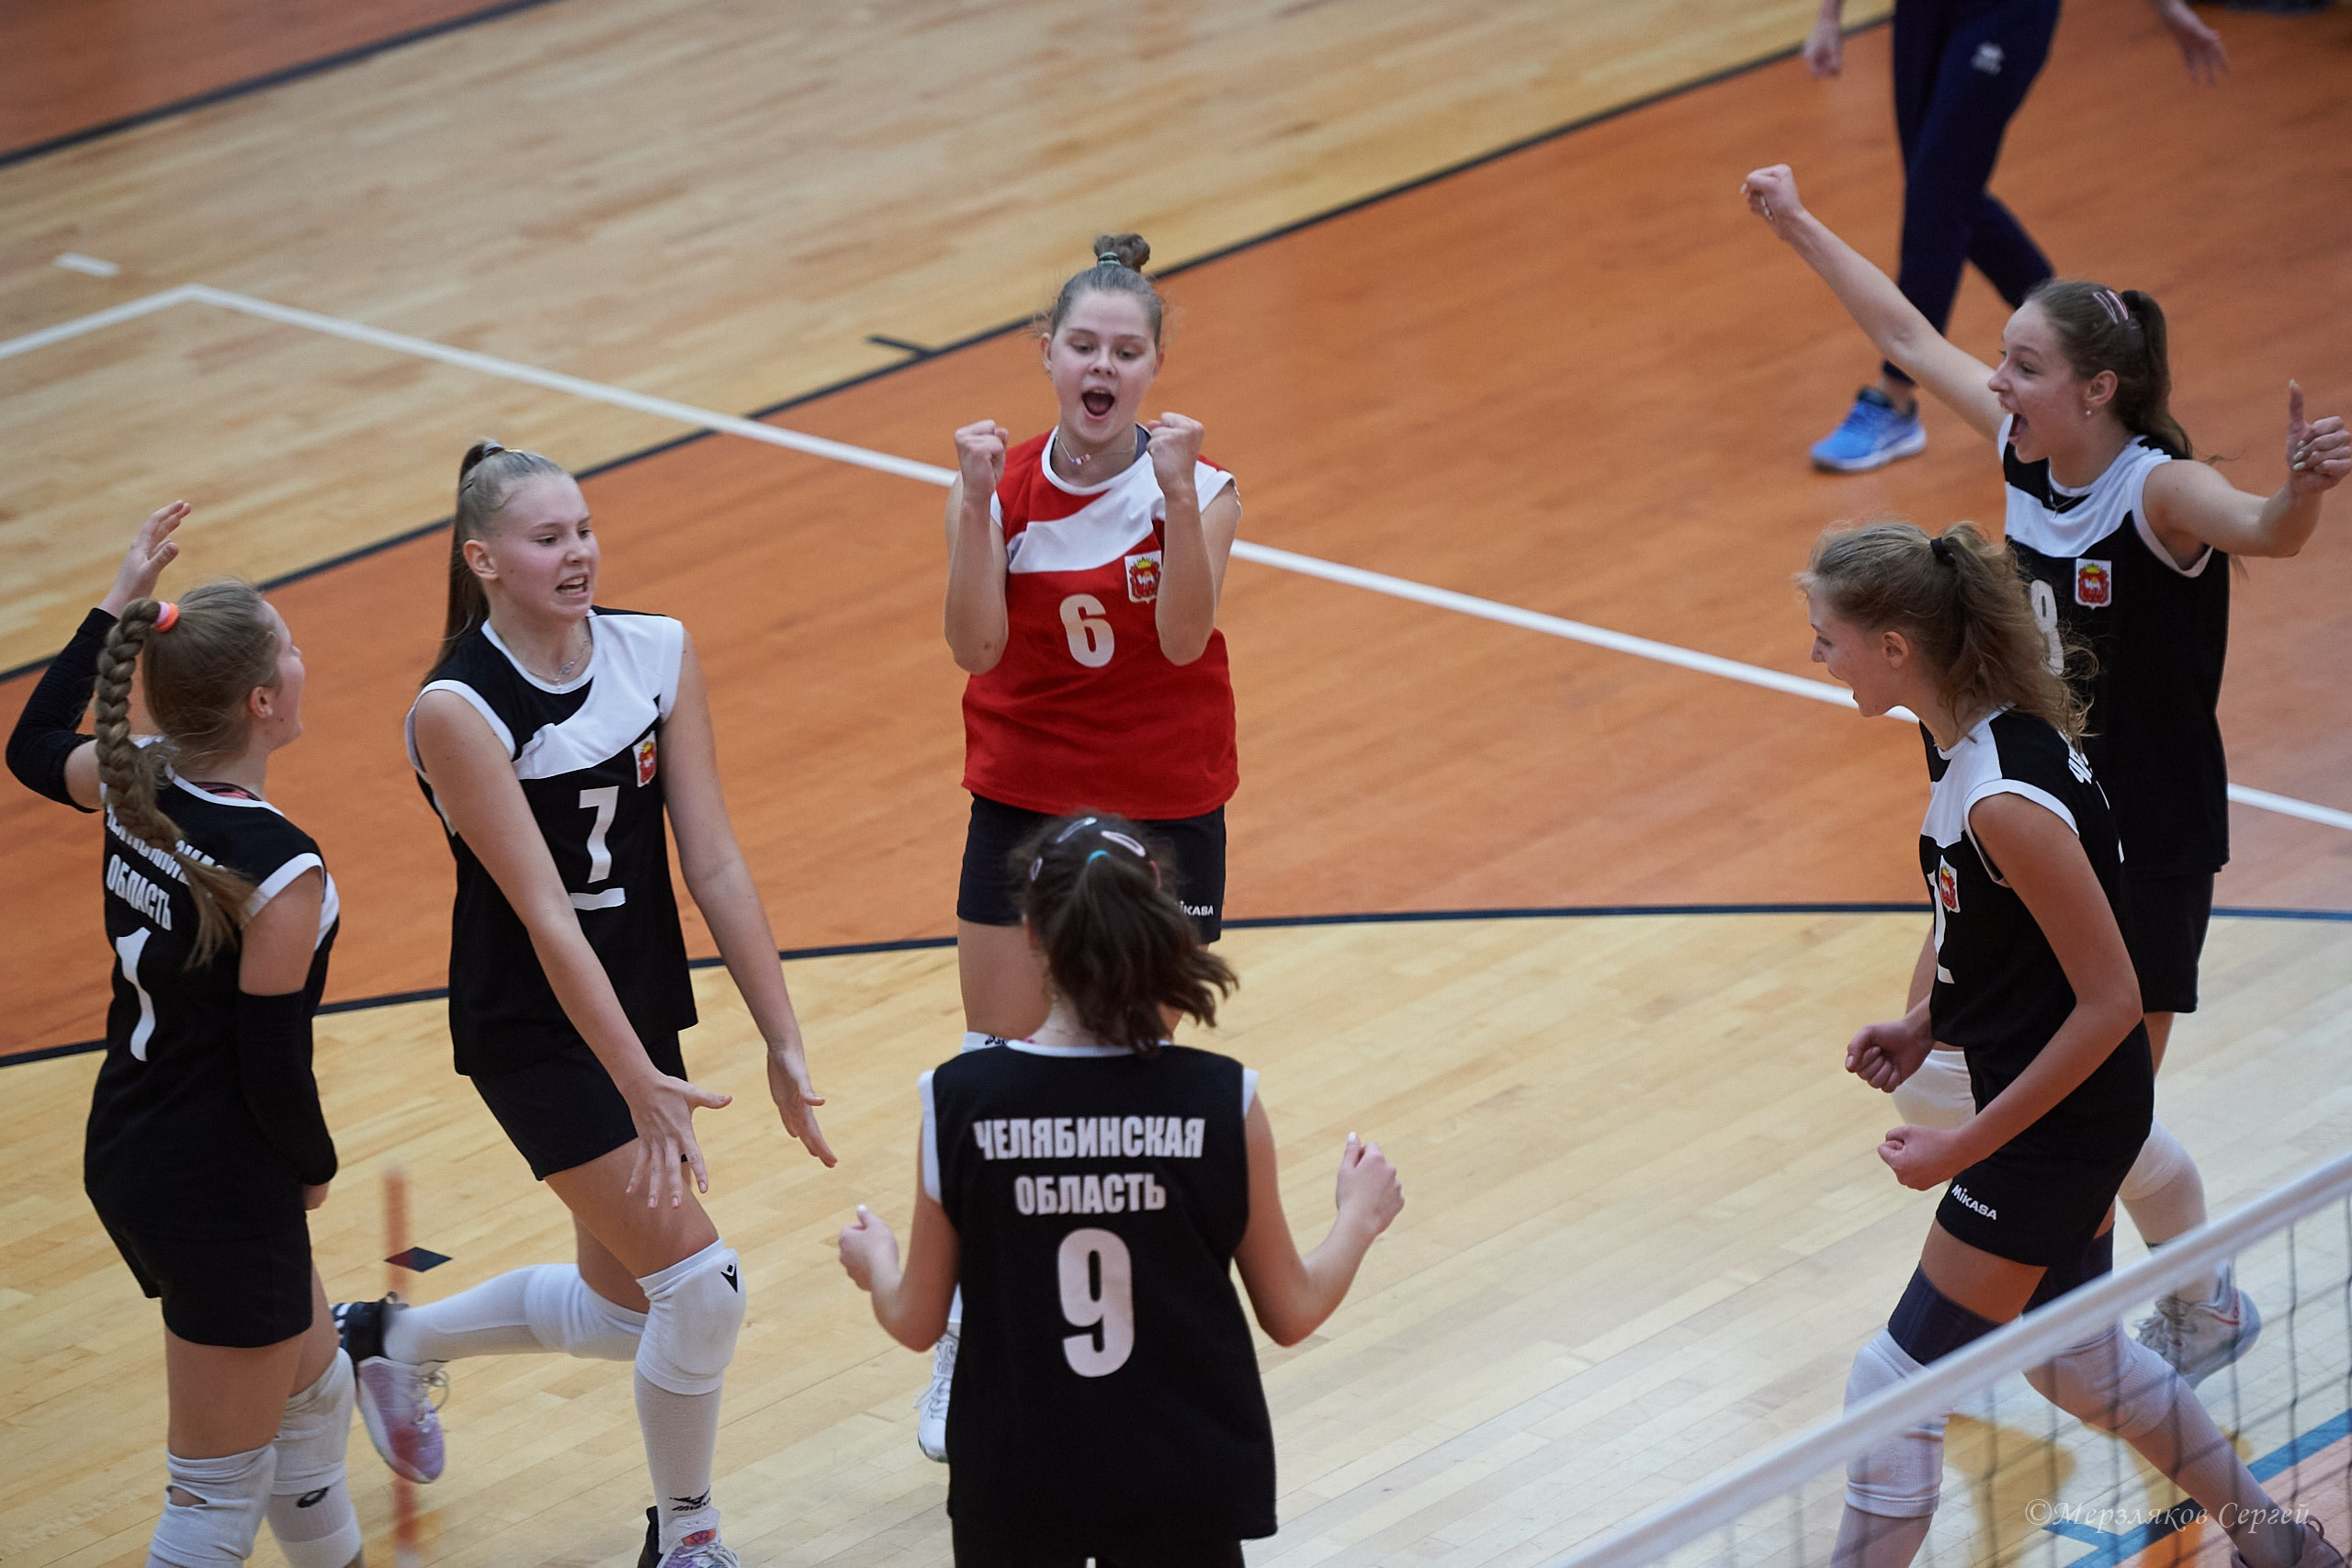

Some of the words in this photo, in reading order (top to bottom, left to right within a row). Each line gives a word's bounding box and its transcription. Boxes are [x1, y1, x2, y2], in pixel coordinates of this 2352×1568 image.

[1059, 593, 1114, 668] 6
[579, 785, 619, 884] 7
[106, 853, 172, 931] ОБЛАСТЬ
[973, 1116, 1206, 1161] ЧЕЛЯБИНСКАЯ
[1014, 1173, 1167, 1215] ОБЛАСТЬ
[1057, 1227, 1135, 1378] 9
